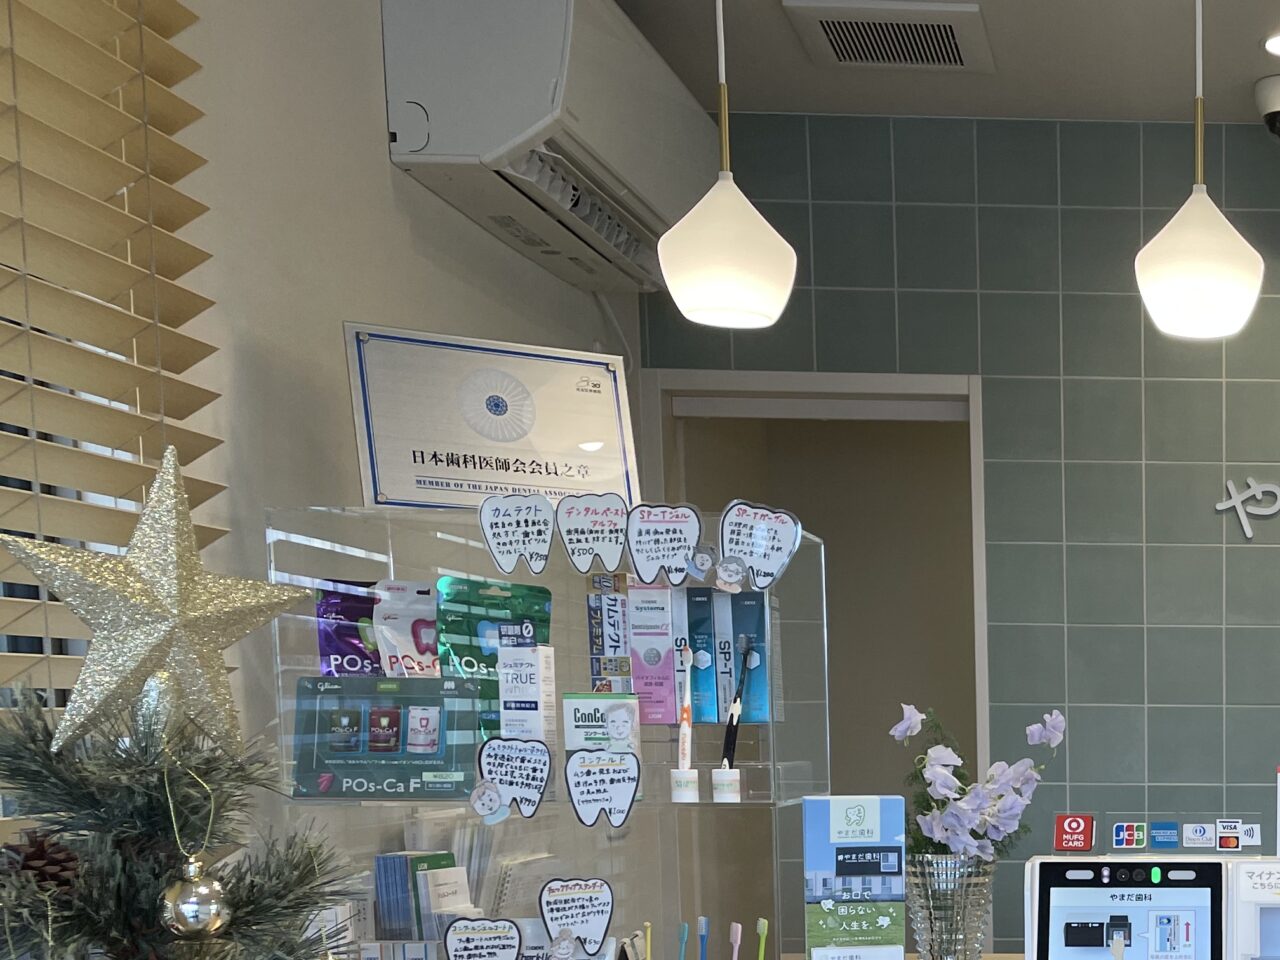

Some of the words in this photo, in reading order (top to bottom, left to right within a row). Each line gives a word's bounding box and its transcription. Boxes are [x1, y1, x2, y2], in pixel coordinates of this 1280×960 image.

[411, 450, 591, 479] 日本歯科医師会会員之章
[416, 479, 451, 488] MEMBER
[454, 481, 464, 489] OF
[467, 482, 482, 490] THE
[485, 483, 509, 492] JAPAN
[491, 505, 542, 518] カムテクト
[565, 507, 626, 518] デンタルペースト
[570, 547, 594, 557] ¥500
[607, 595, 620, 655] カムテクト
[330, 655, 379, 672] POs-
[388, 654, 440, 672] POs-
[449, 655, 499, 673] POs-
[719, 640, 732, 678] SP-T
[505, 673, 536, 685] TRUE
[574, 708, 606, 723] ConCo
[342, 779, 404, 792] POs-Ca
[409, 779, 421, 792] F
[1115, 825, 1144, 846] JCB
[842, 891, 872, 899] お口で
[1110, 893, 1152, 902] やまだ歯科
[838, 906, 875, 915] 困らない
